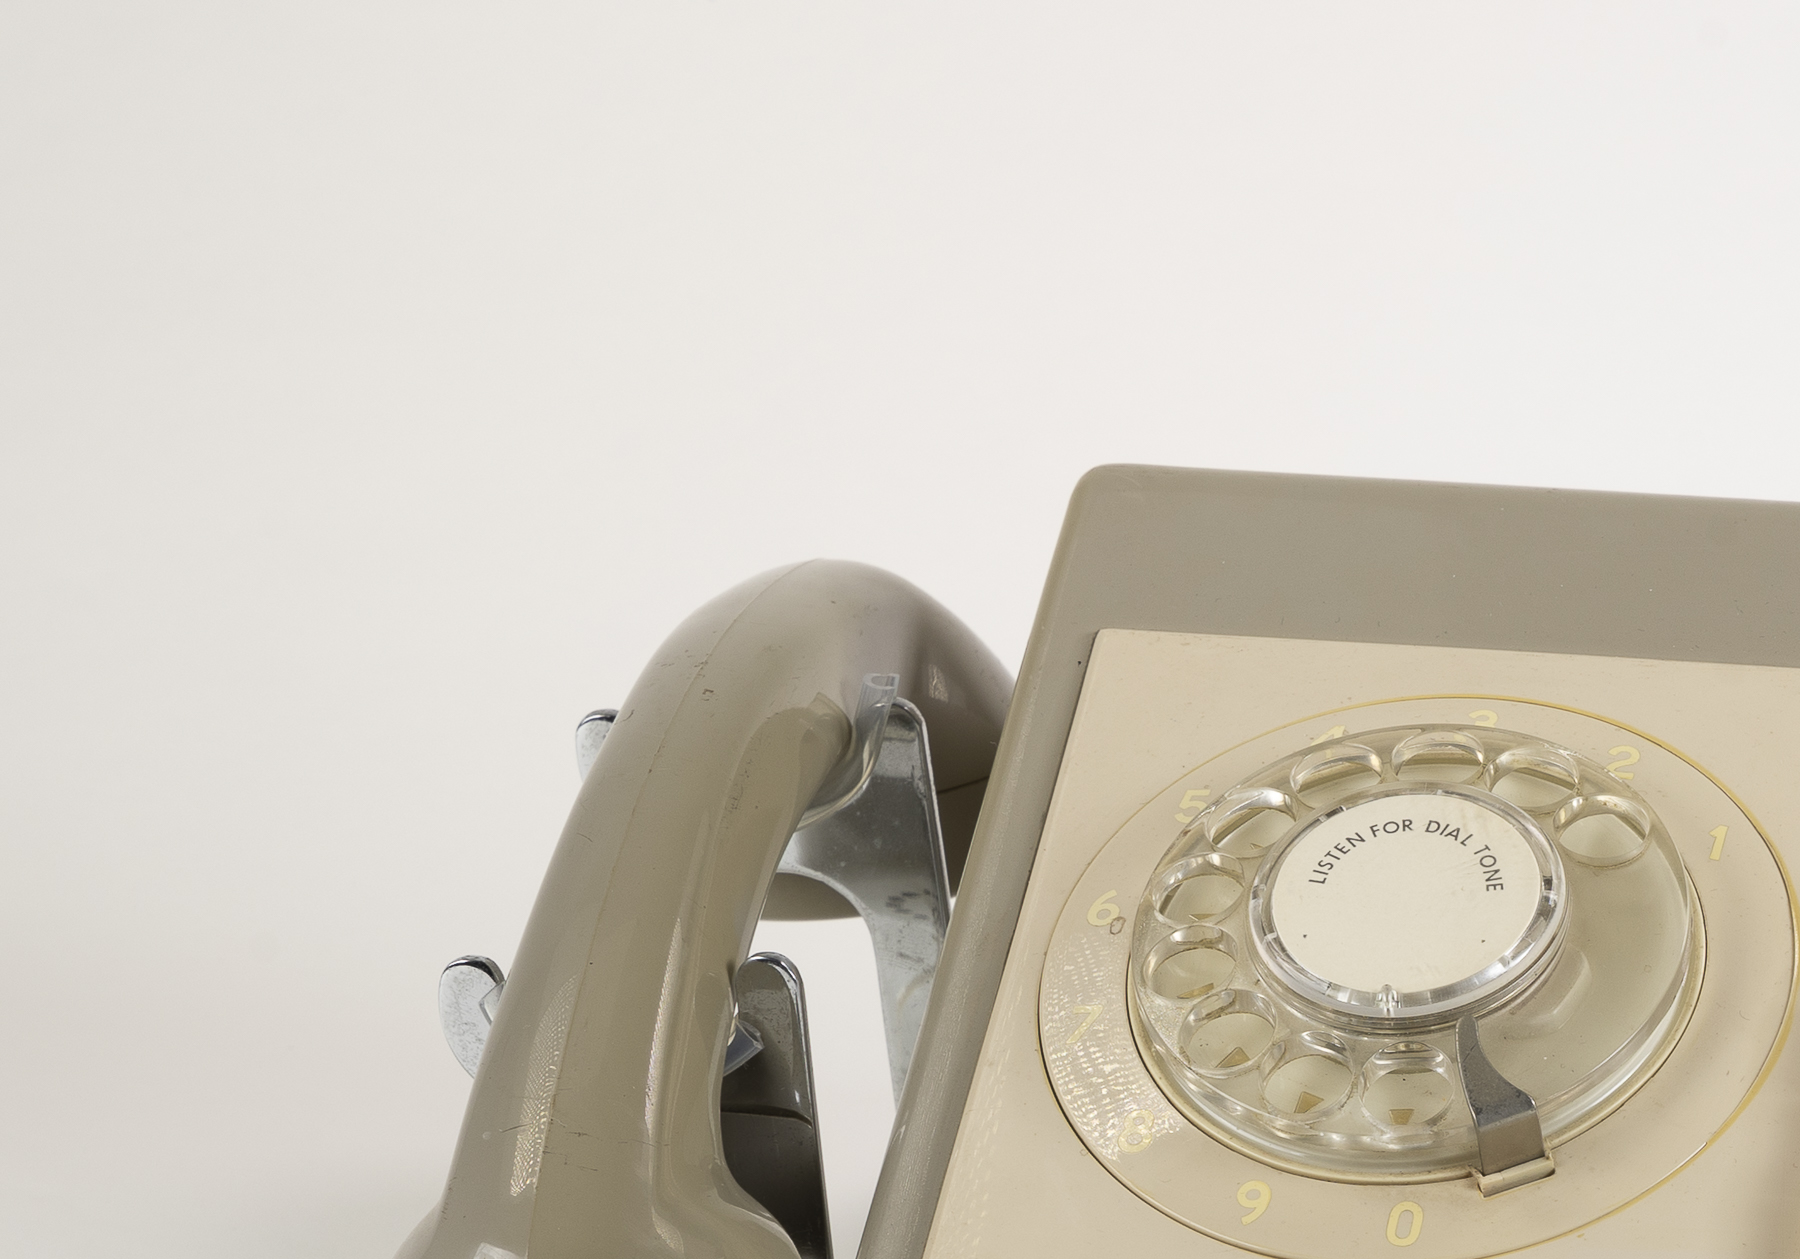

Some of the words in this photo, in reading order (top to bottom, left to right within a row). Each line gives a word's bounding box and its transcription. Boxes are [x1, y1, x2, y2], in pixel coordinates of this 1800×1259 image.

[1607, 745, 1641, 780] 2
[1173, 788, 1211, 824] 5
[1308, 832, 1366, 884] LISTEN
[1369, 819, 1413, 838] FOR
[1424, 820, 1474, 847] DIAL
[1473, 844, 1504, 892] TONE
[1708, 824, 1730, 862] 1
[1086, 889, 1119, 927] 6
[1065, 1004, 1104, 1045] 7
[1116, 1108, 1156, 1153] 8
[1236, 1179, 1273, 1226] 9
[1385, 1200, 1425, 1248] 0
